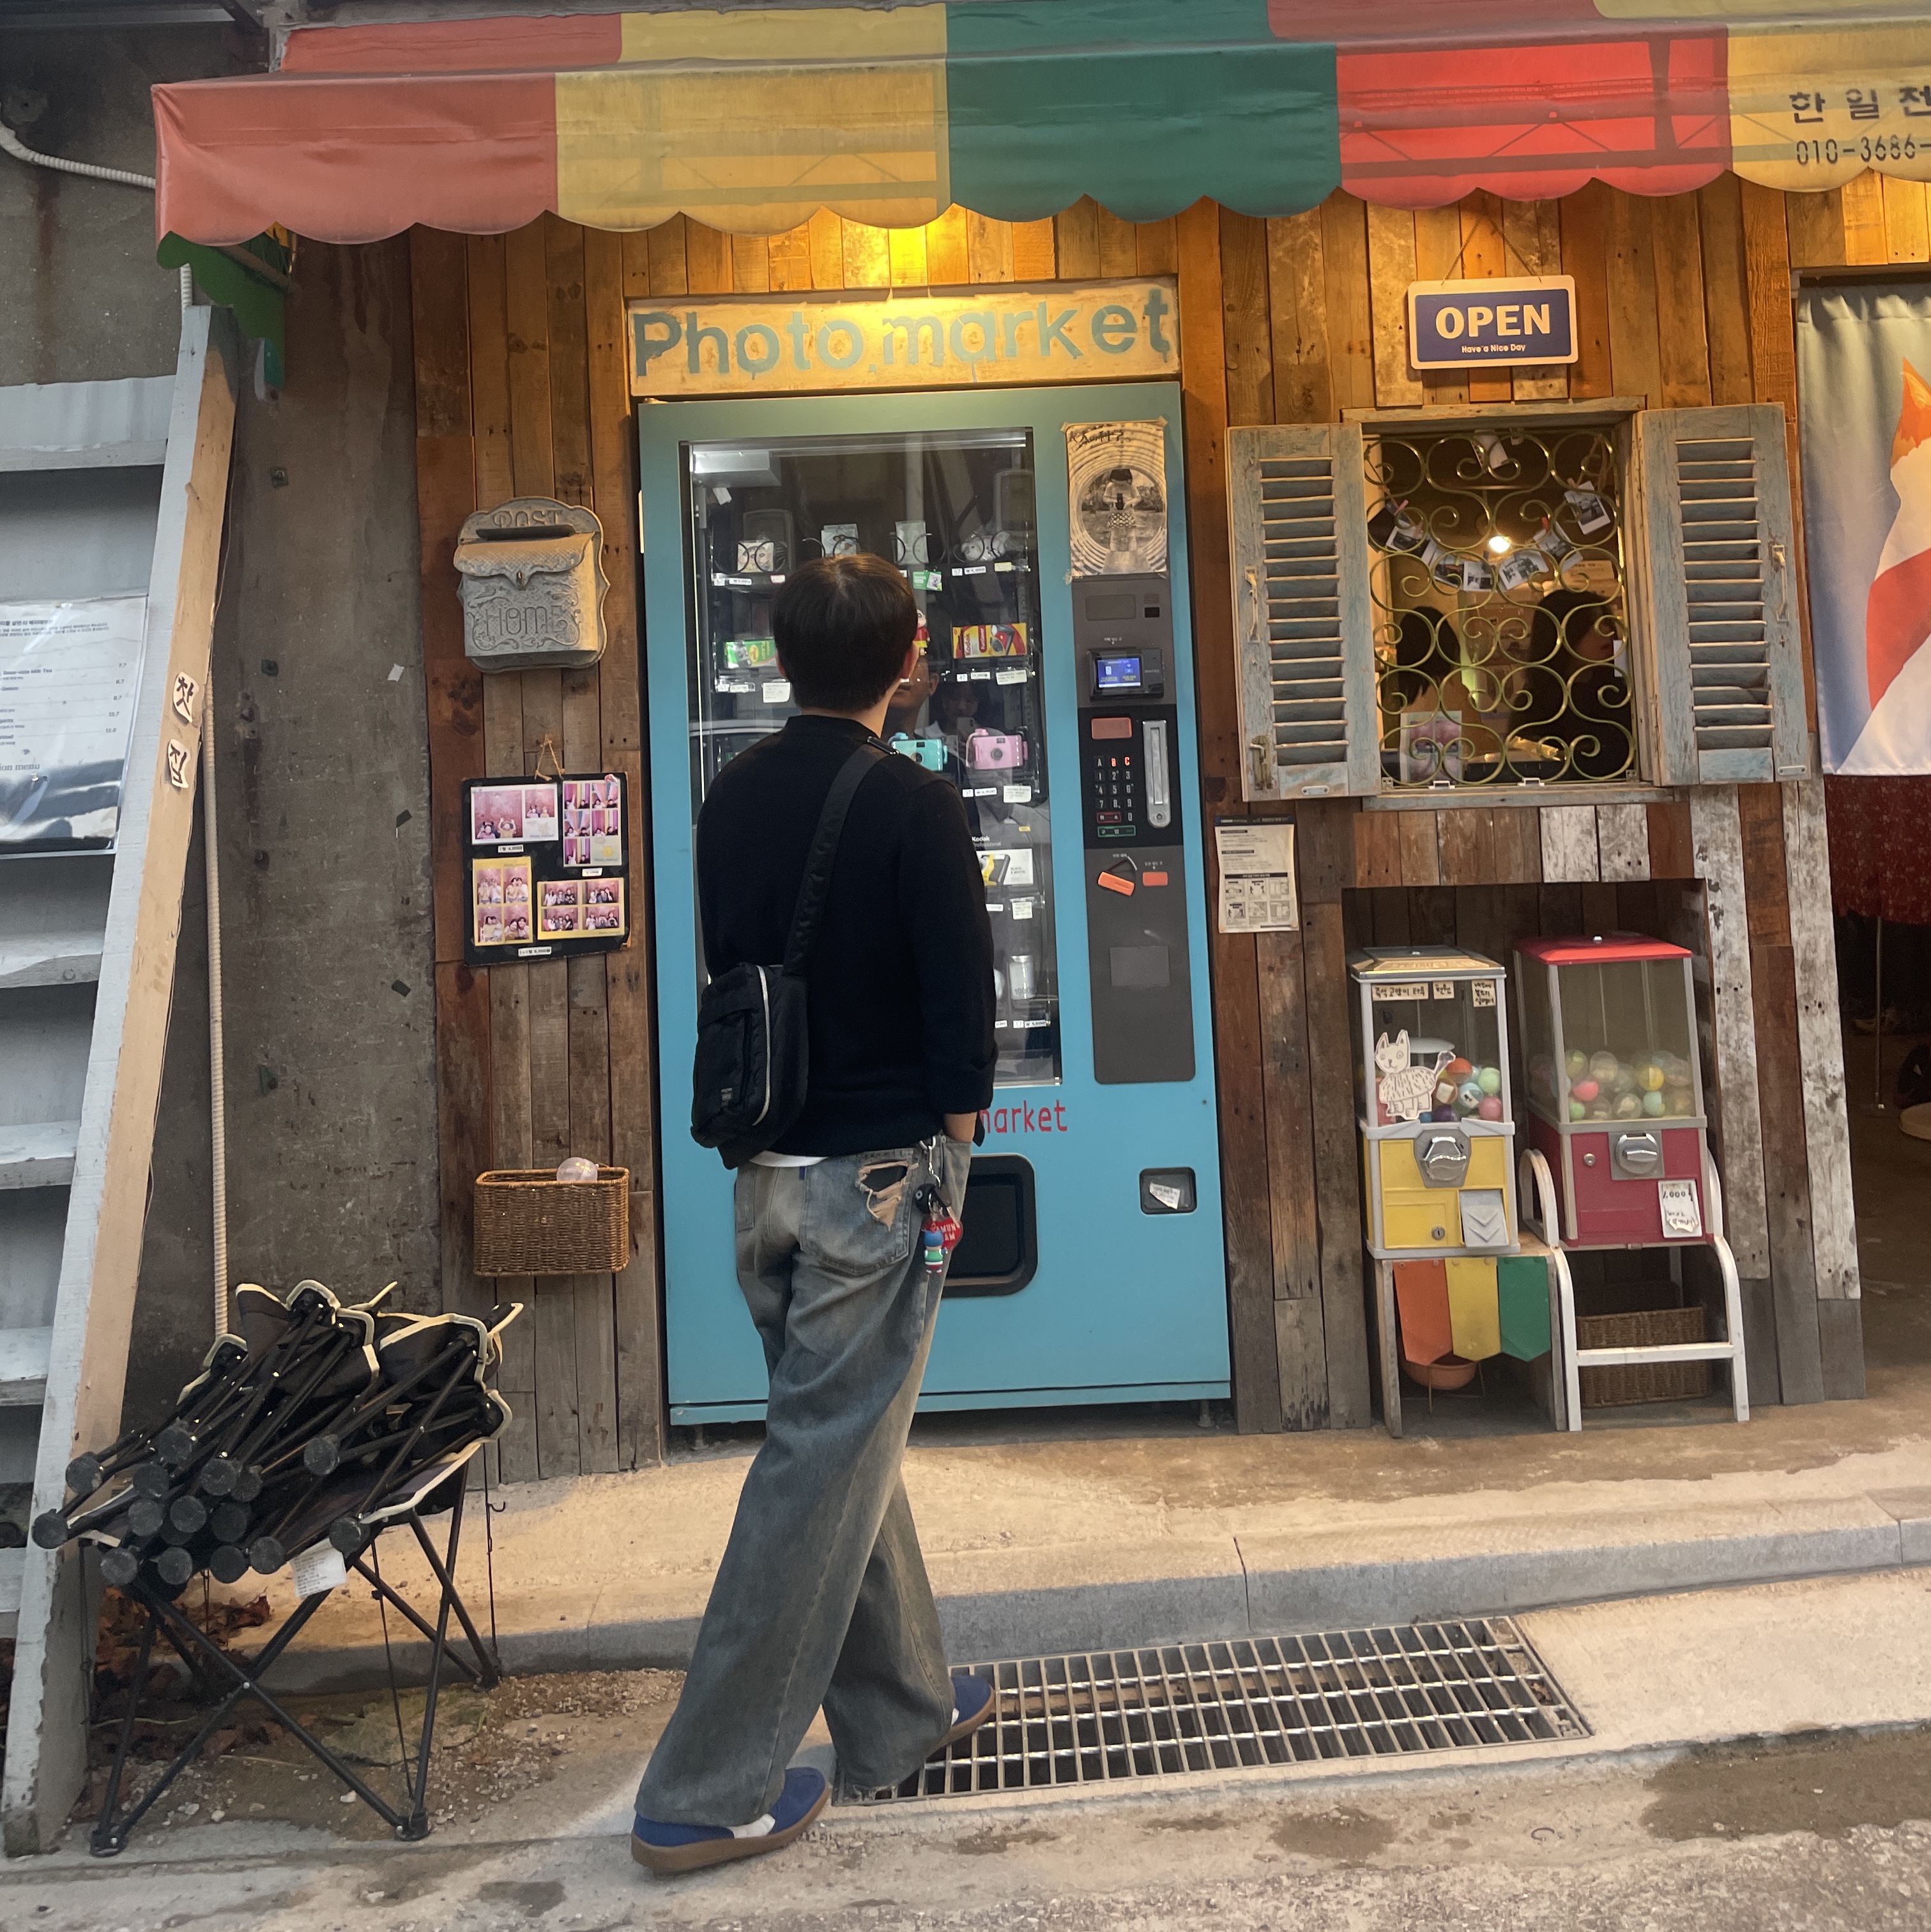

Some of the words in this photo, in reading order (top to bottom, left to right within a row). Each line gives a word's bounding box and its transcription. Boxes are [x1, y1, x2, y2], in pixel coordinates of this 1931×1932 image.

[1435, 303, 1550, 339] OPEN
[1510, 343, 1526, 352] Day
[482, 605, 567, 637] HOME
[1124, 756, 1130, 766] C
[1389, 987, 1410, 997] 고양이
